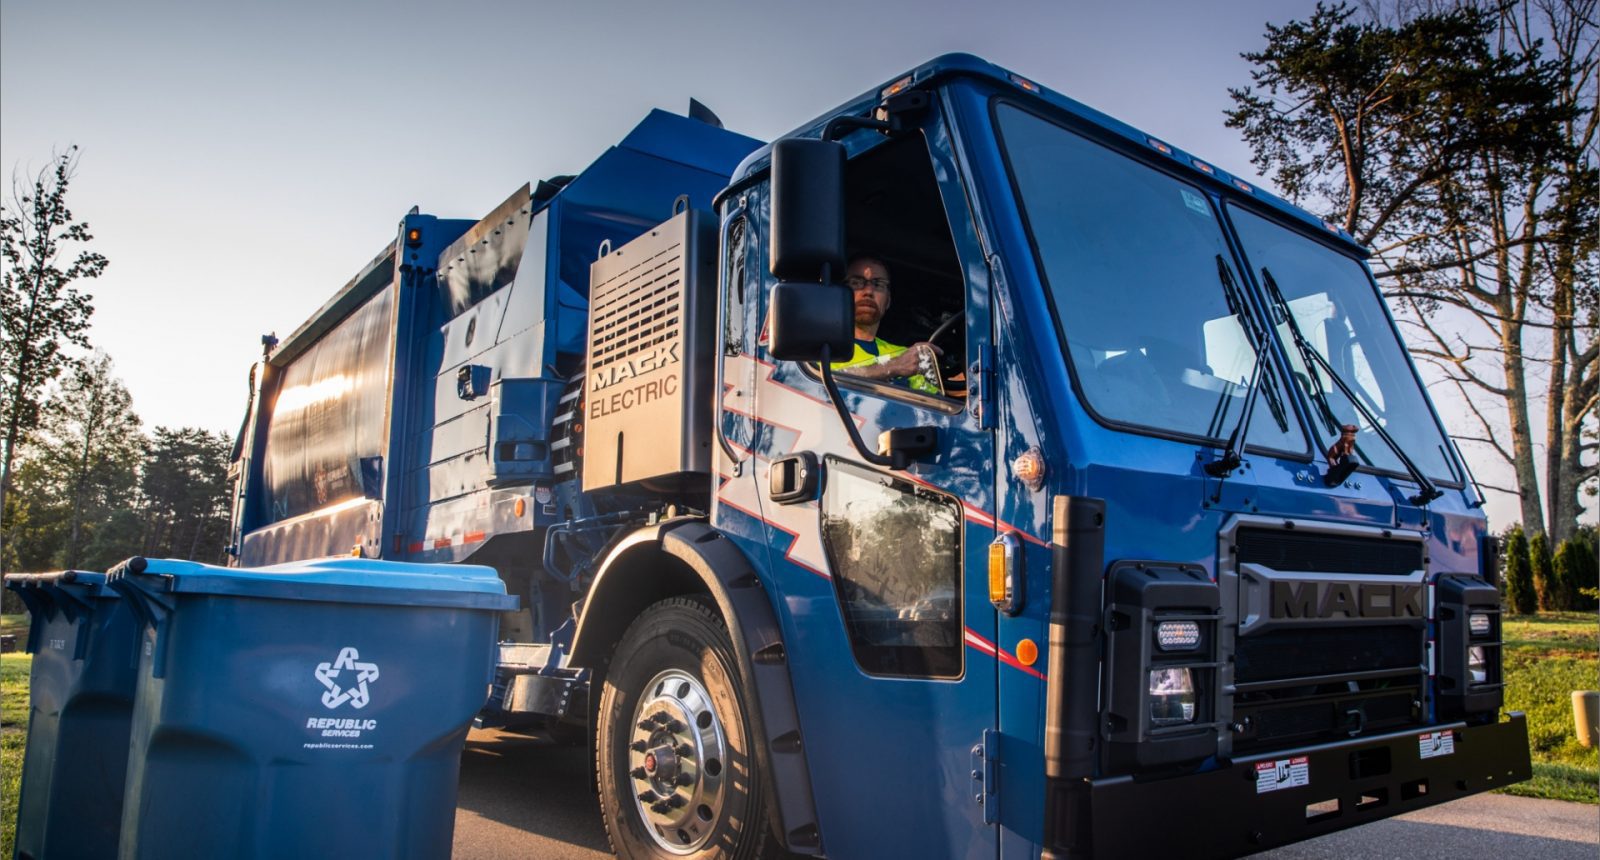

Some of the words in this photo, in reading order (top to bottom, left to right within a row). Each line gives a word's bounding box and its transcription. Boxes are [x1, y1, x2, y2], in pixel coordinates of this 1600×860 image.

[591, 342, 679, 392] MACK
[590, 374, 678, 420] ELECTRIC
[1270, 581, 1422, 618] MACK
[306, 717, 377, 730] REPUBLIC
